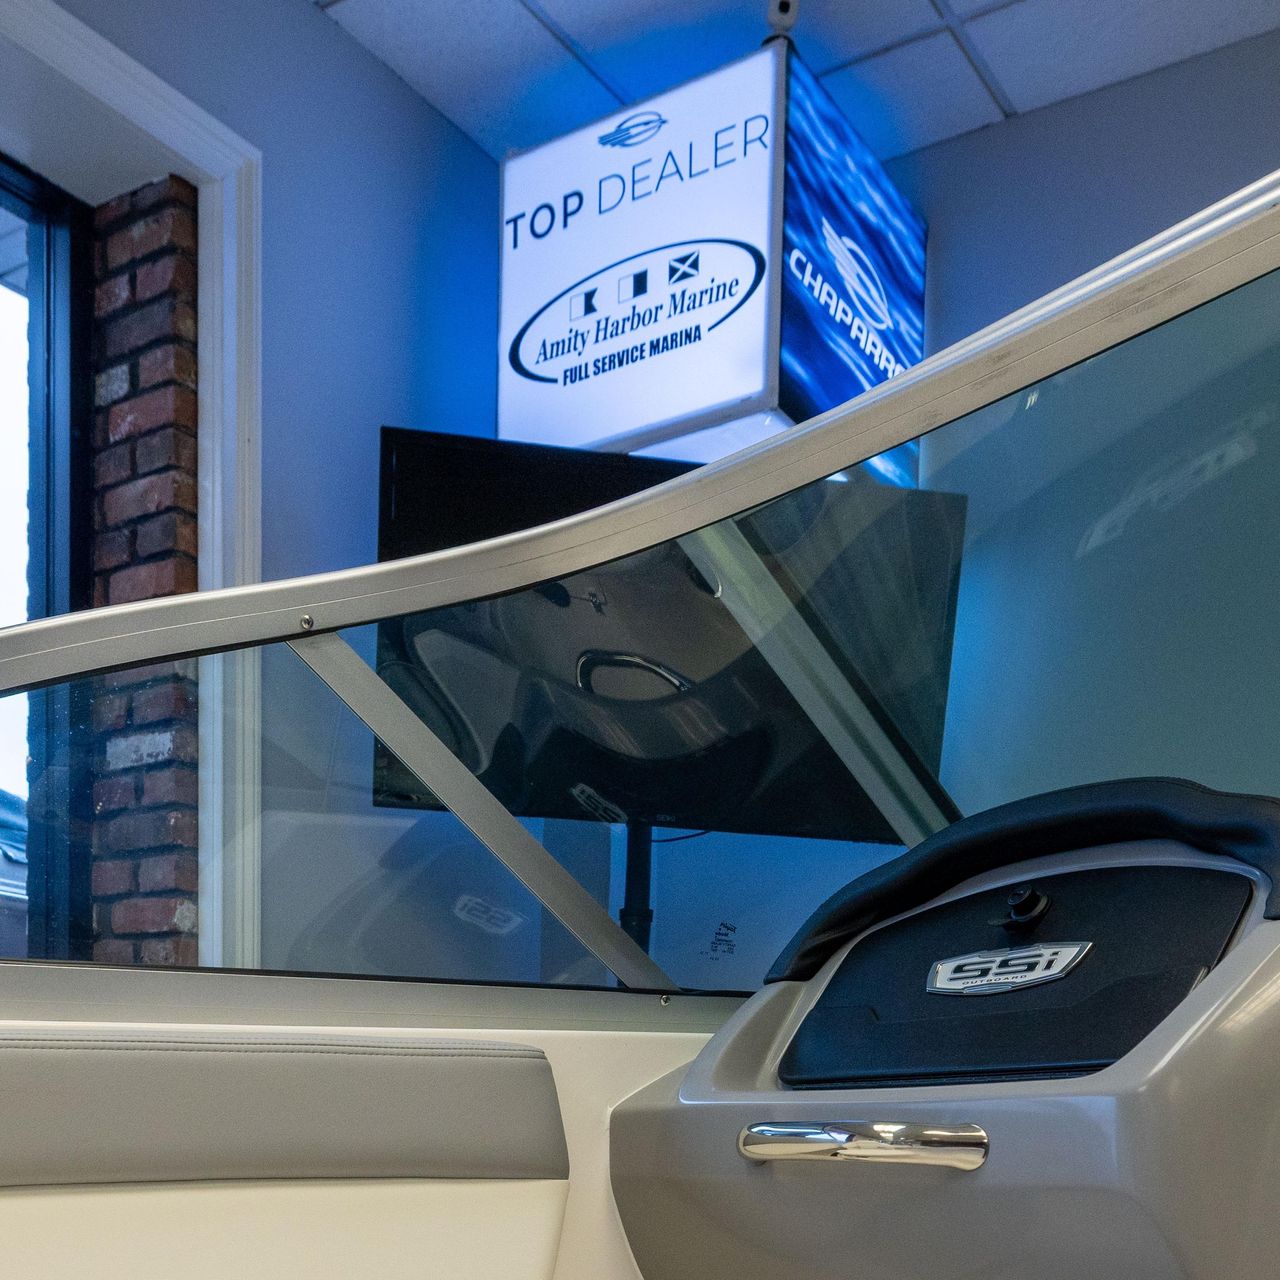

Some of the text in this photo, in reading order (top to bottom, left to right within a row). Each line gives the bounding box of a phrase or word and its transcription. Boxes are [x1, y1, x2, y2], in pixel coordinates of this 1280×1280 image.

[505, 113, 770, 250] TOP DEALER
[535, 277, 740, 365] Amity Harbor Marine
[562, 324, 703, 386] FULL SERVICE MARINA
[947, 951, 1062, 982] SSi
[962, 974, 1028, 985] OUTBOARD
